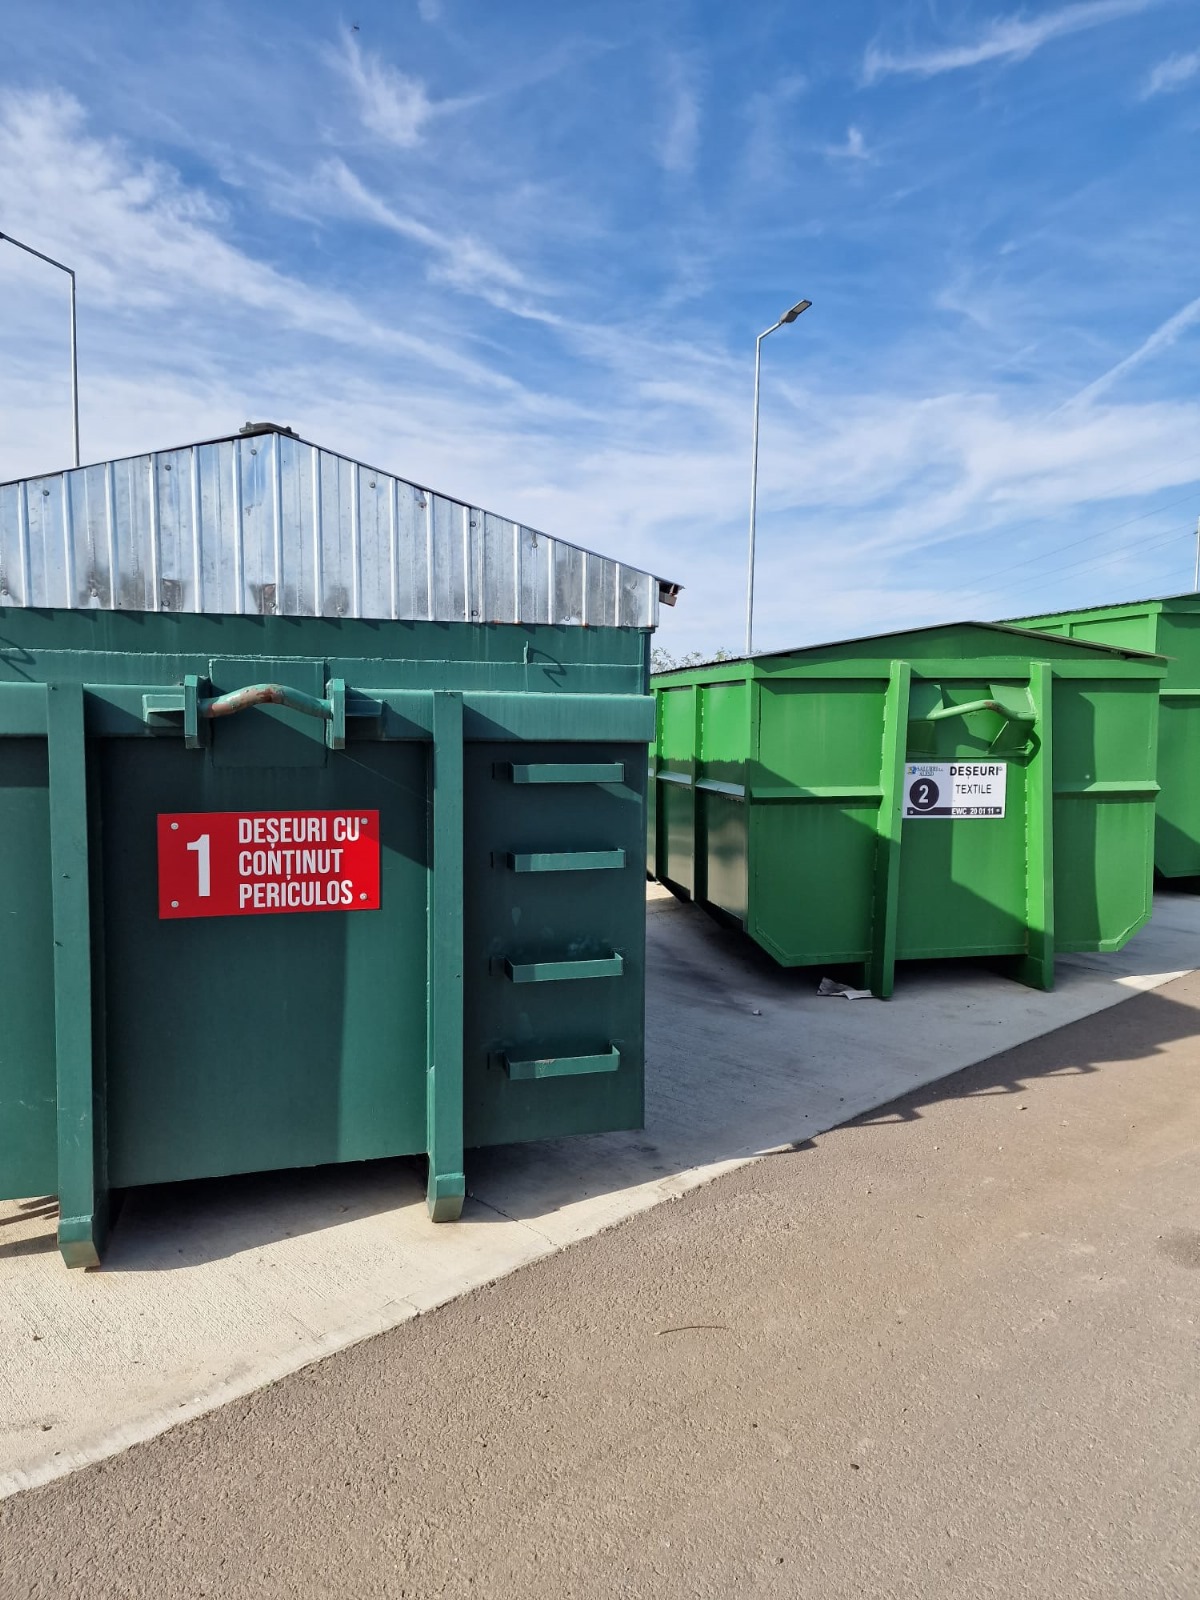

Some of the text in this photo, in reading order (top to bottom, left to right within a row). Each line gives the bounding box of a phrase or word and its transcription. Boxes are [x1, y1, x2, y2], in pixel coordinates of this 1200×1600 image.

[950, 766, 999, 779] DEȘEURI
[918, 784, 929, 803] 2
[955, 784, 992, 794] TEXTILE
[951, 807, 994, 815] EWC 20 01 11
[238, 816, 360, 849] DEȘEURI CU
[186, 834, 211, 897] 1
[238, 848, 344, 881] CONȚINUT
[239, 879, 353, 909] PERICULOS
